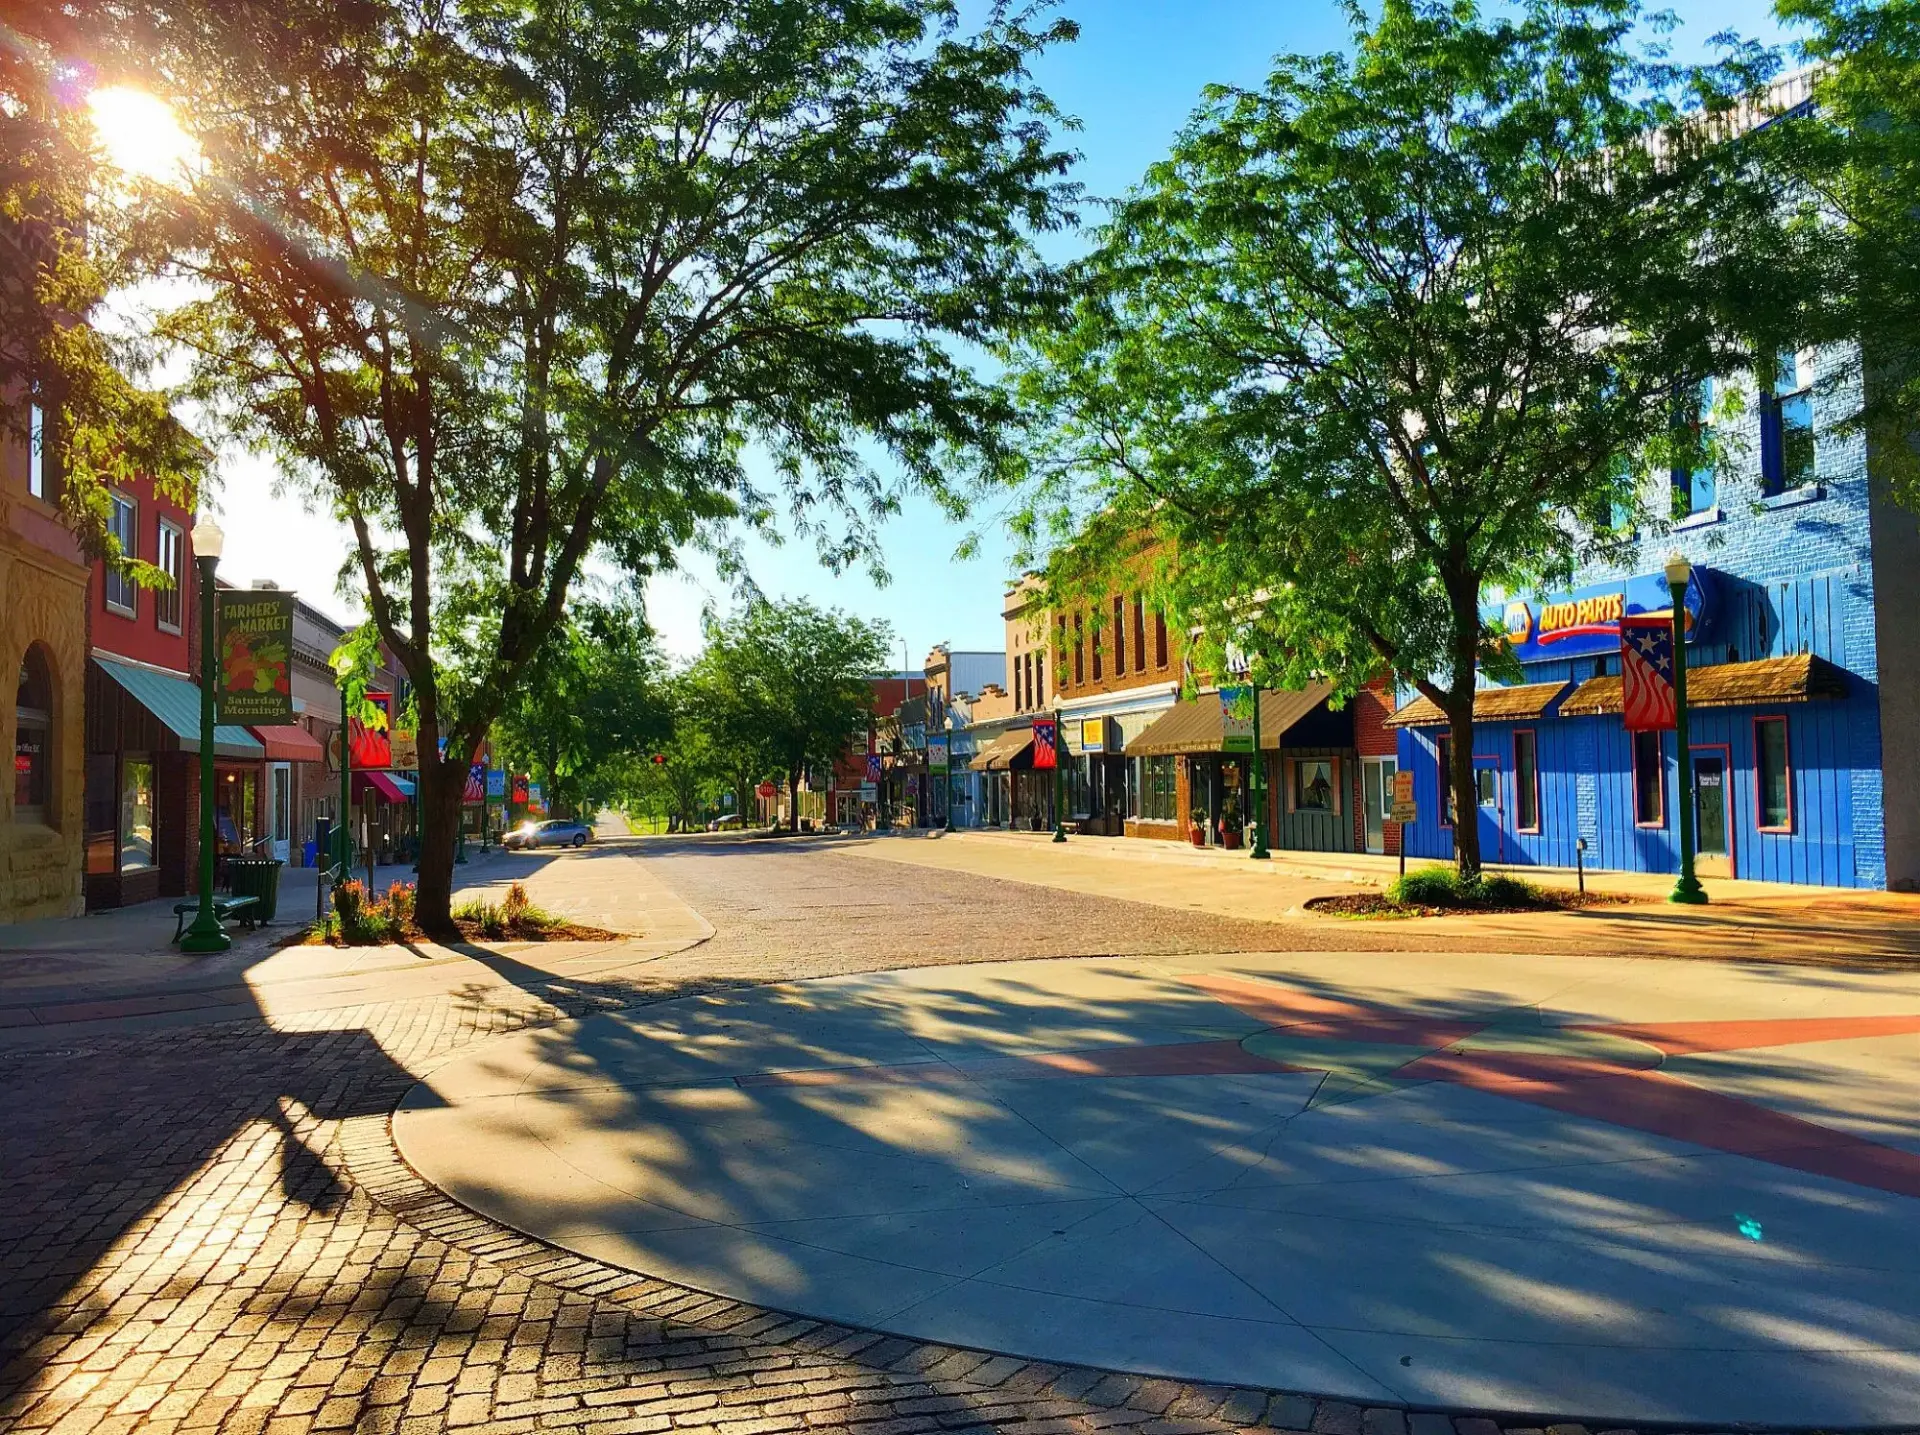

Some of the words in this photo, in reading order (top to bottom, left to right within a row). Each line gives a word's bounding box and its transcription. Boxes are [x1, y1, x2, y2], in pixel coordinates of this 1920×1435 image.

[224, 601, 280, 619] FARMERS'
[1539, 602, 1577, 631] AUTO
[1577, 593, 1624, 626] PARTS
[239, 615, 289, 633] MARKET
[223, 705, 286, 716] Mornings
[228, 696, 282, 707] Saturday
